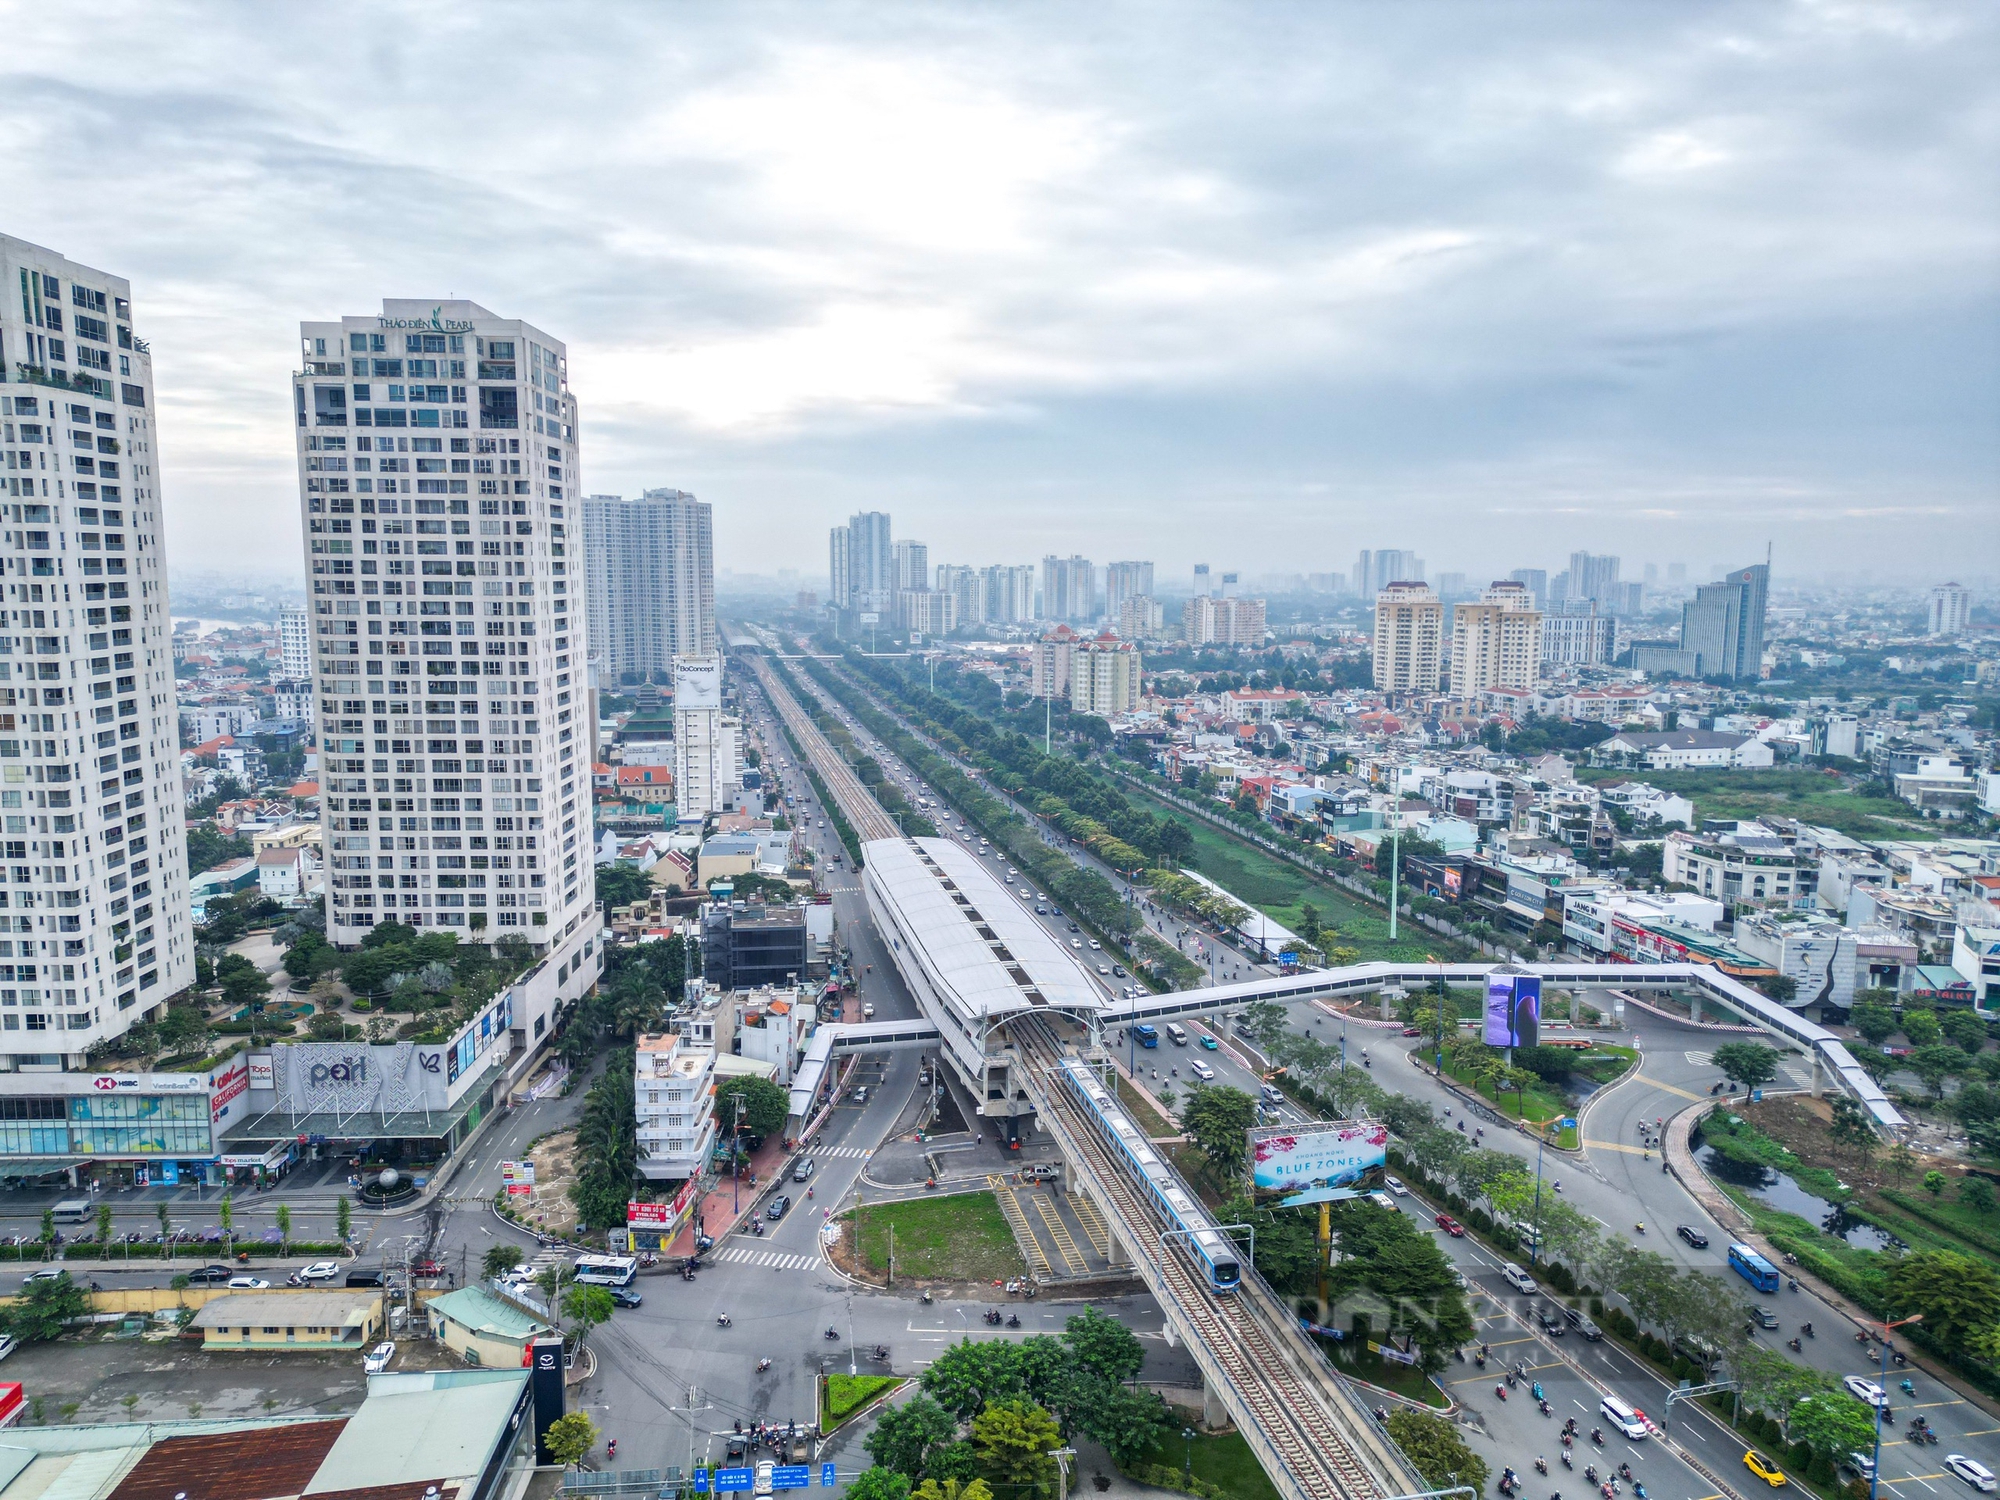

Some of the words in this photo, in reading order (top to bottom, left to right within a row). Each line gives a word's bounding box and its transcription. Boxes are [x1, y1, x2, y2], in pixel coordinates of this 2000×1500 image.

[445, 319, 475, 330] PEARL
[679, 665, 714, 673] BoConcept
[1573, 900, 1590, 912] JANG
[250, 1065, 271, 1075] Tops
[152, 1082, 191, 1090] VietinBank
[213, 1078, 247, 1106] CALIFORNIA
[1276, 1161, 1311, 1176] BLUE
[1316, 1156, 1363, 1170] ZONES
